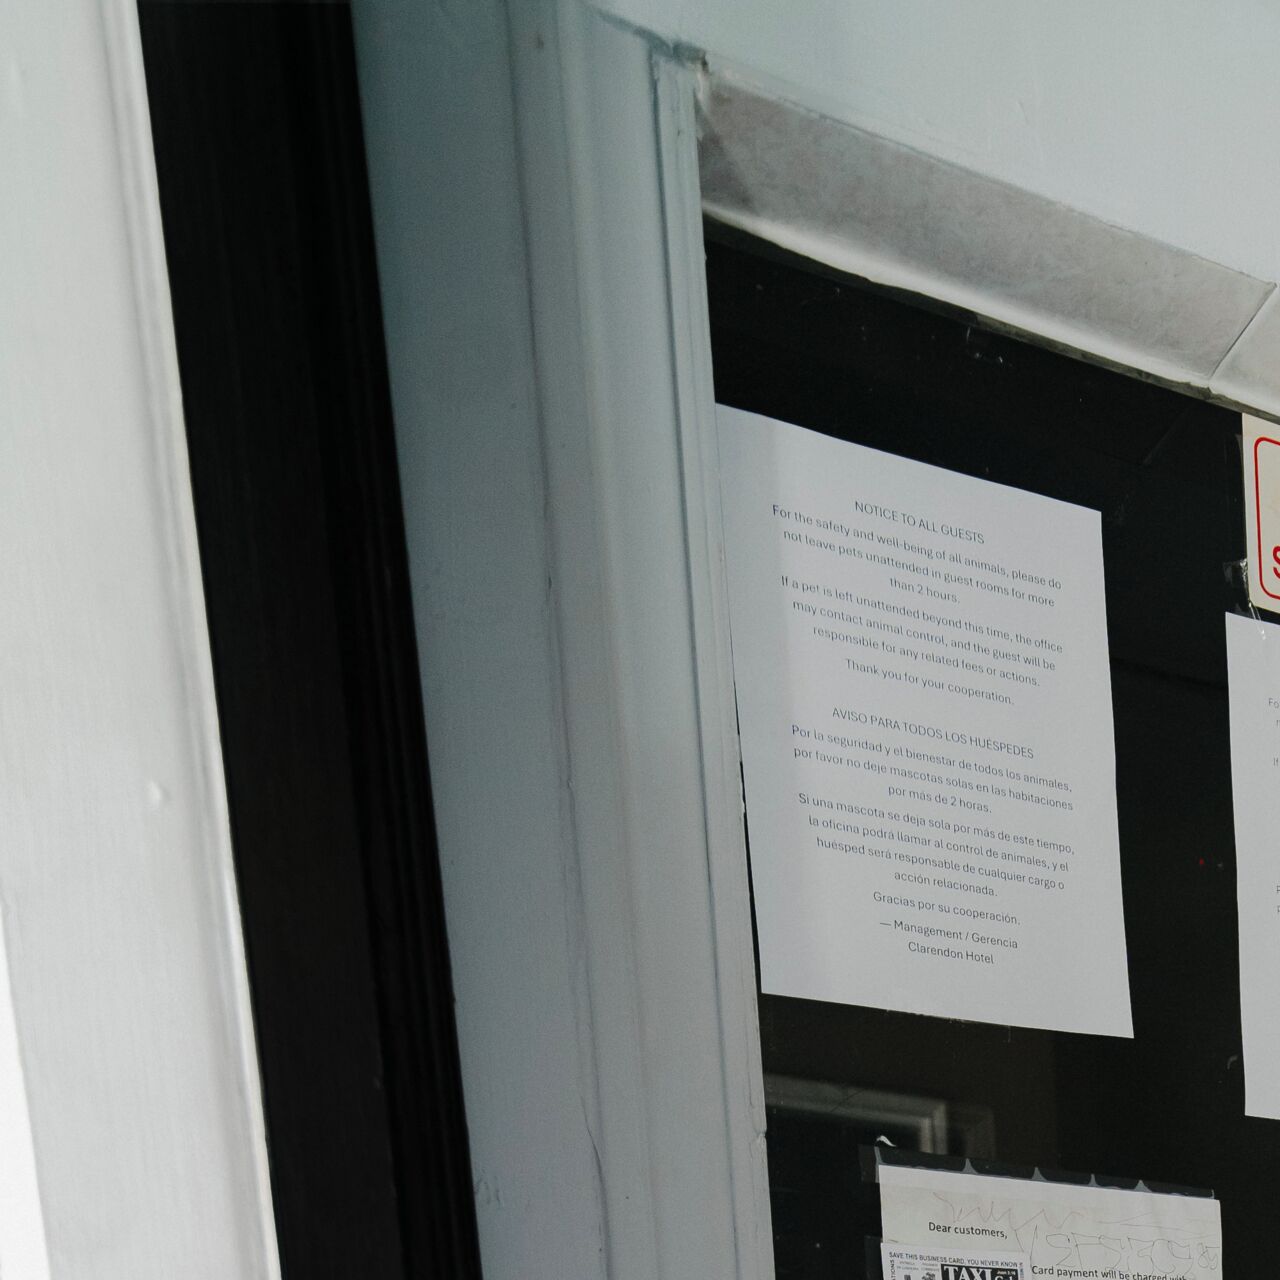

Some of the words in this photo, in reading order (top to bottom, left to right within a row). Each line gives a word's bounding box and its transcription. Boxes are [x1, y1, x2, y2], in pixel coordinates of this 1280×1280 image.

[855, 501, 897, 521] NOTICE
[901, 513, 916, 526] TO
[918, 518, 937, 533] ALL
[940, 524, 985, 544] GUESTS
[772, 504, 790, 519] For
[794, 512, 813, 525] the
[816, 519, 850, 537] safety
[853, 530, 874, 541] and
[876, 535, 934, 560] well-being
[935, 551, 946, 560] of
[949, 553, 962, 564] all
[964, 558, 1009, 578] animals,
[1011, 569, 1046, 586] please
[1048, 578, 1061, 590] do
[783, 531, 802, 543] not
[805, 534, 835, 551] leave
[838, 545, 863, 558] pets
[865, 553, 929, 576] unattended
[931, 570, 941, 579] in
[944, 573, 973, 587] guest
[976, 580, 1009, 596] rooms
[1011, 587, 1025, 600] for
[1028, 594, 1054, 607] more
[890, 578, 915, 593] than
[917, 583, 923, 594] 2
[926, 586, 960, 604] hours.
[847, 659, 879, 675] Thank
[881, 669, 902, 681] you
[904, 672, 918, 684] for
[921, 678, 944, 690] your
[947, 683, 1014, 706] cooperation.
[832, 707, 868, 723] AVISO
[870, 715, 901, 731] PARA
[903, 722, 943, 739] TODOS
[945, 731, 967, 745] LOS
[969, 736, 1034, 759] HUÉSPEDES
[873, 891, 916, 907] Gracias
[918, 901, 935, 911] por
[938, 904, 950, 914] su
[953, 906, 1020, 925] cooperación.
[894, 919, 963, 940] Management
[971, 932, 1018, 949] Gerencia
[908, 941, 964, 959] Clarendon
[965, 950, 994, 964] Hotel
[928, 1221, 952, 1233] Dear
[954, 1226, 1008, 1239] customers,
[919, 1254, 948, 1263] BUSINESS
[1031, 1265, 1054, 1275] Card
[1056, 1268, 1098, 1279] payment
[1100, 1270, 1117, 1279] will
[1118, 1270, 1130, 1280] be
